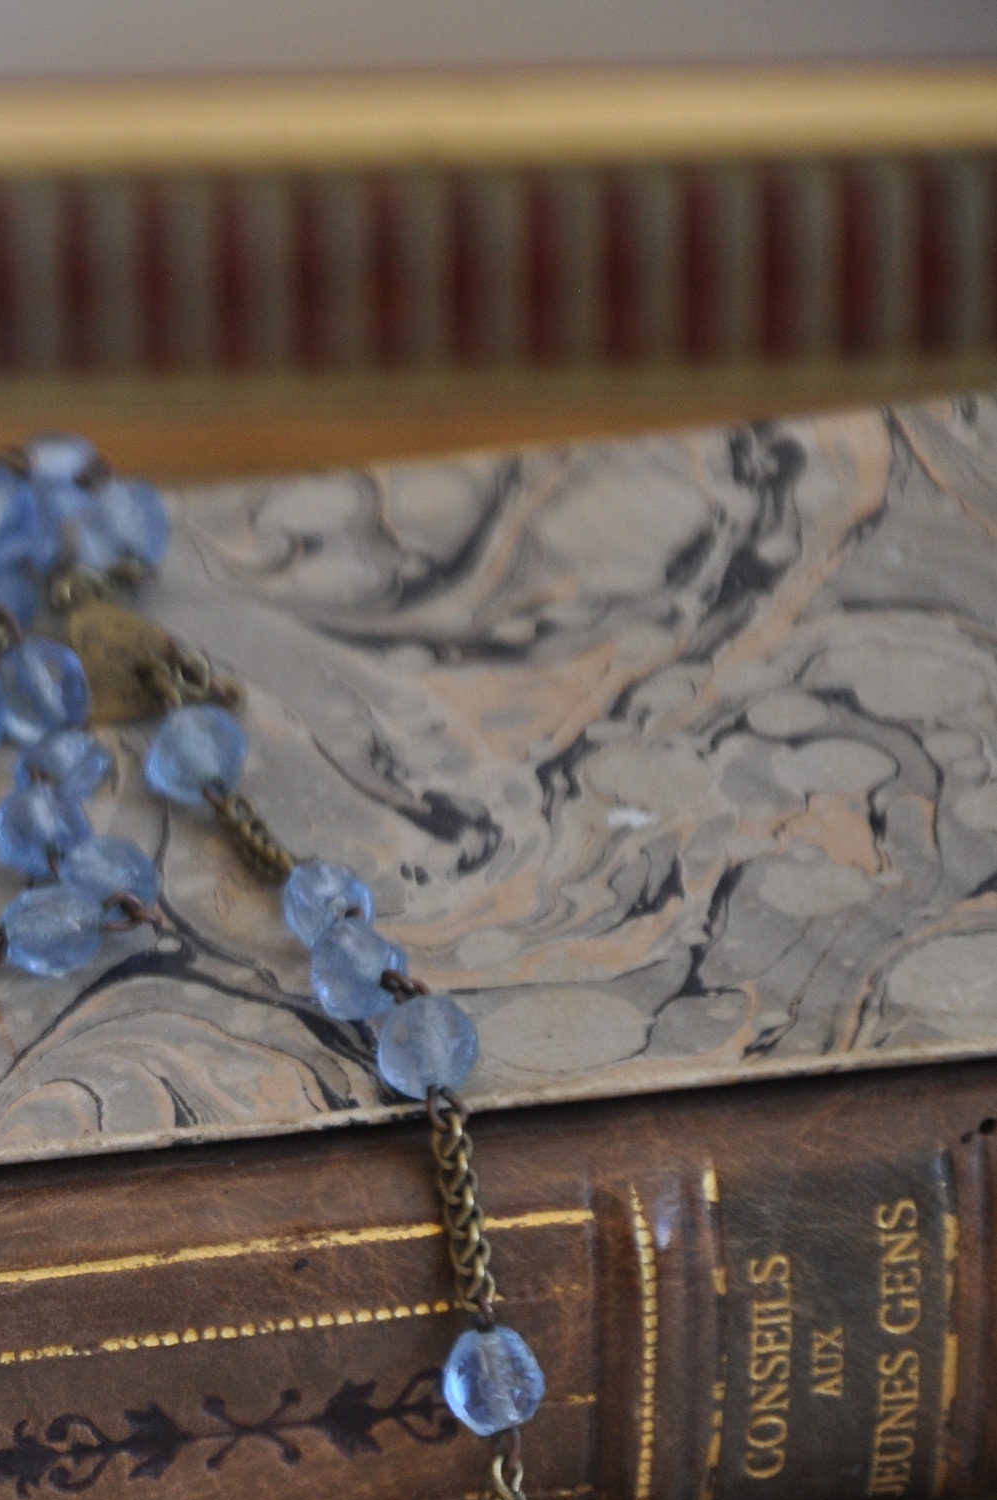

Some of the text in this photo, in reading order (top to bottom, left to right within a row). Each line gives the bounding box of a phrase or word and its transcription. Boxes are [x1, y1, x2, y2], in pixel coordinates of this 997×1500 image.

[745, 1253, 792, 1480] CONSEILS
[810, 1325, 845, 1398] AUX
[867, 1198, 923, 1498] JEUNES GENS
